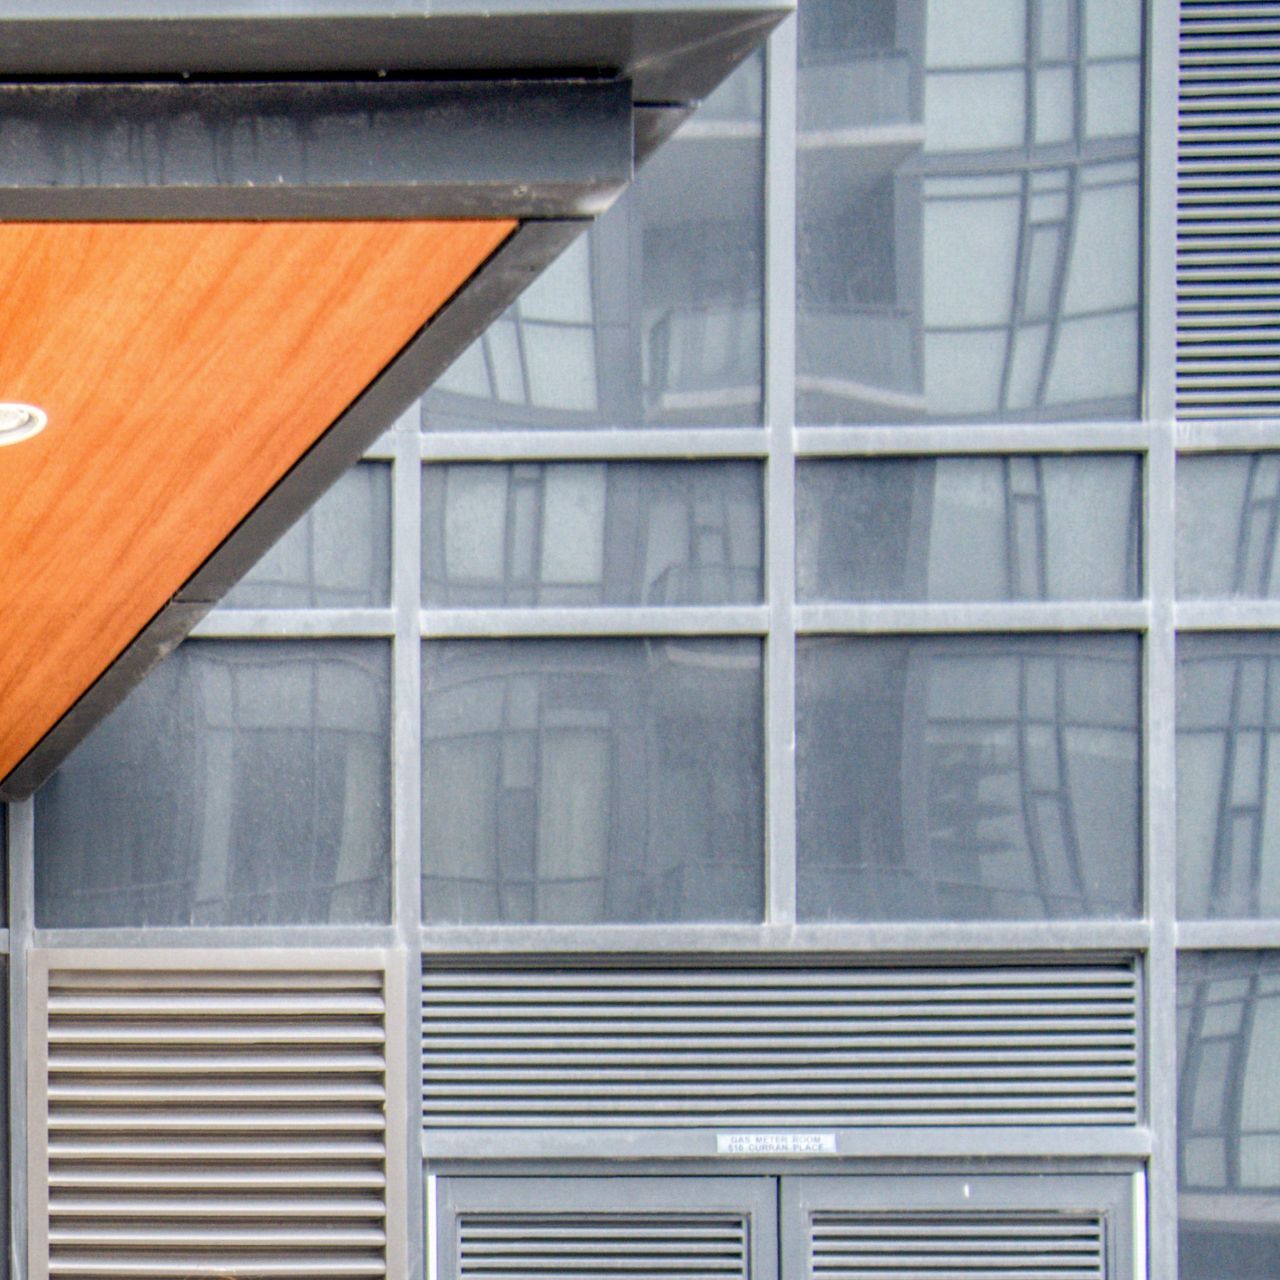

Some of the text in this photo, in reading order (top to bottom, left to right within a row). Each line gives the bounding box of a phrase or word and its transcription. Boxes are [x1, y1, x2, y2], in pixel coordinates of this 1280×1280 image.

[730, 1136, 822, 1144] GAS METER ROOM
[728, 1144, 825, 1152] 510 CURRAN PLACE
